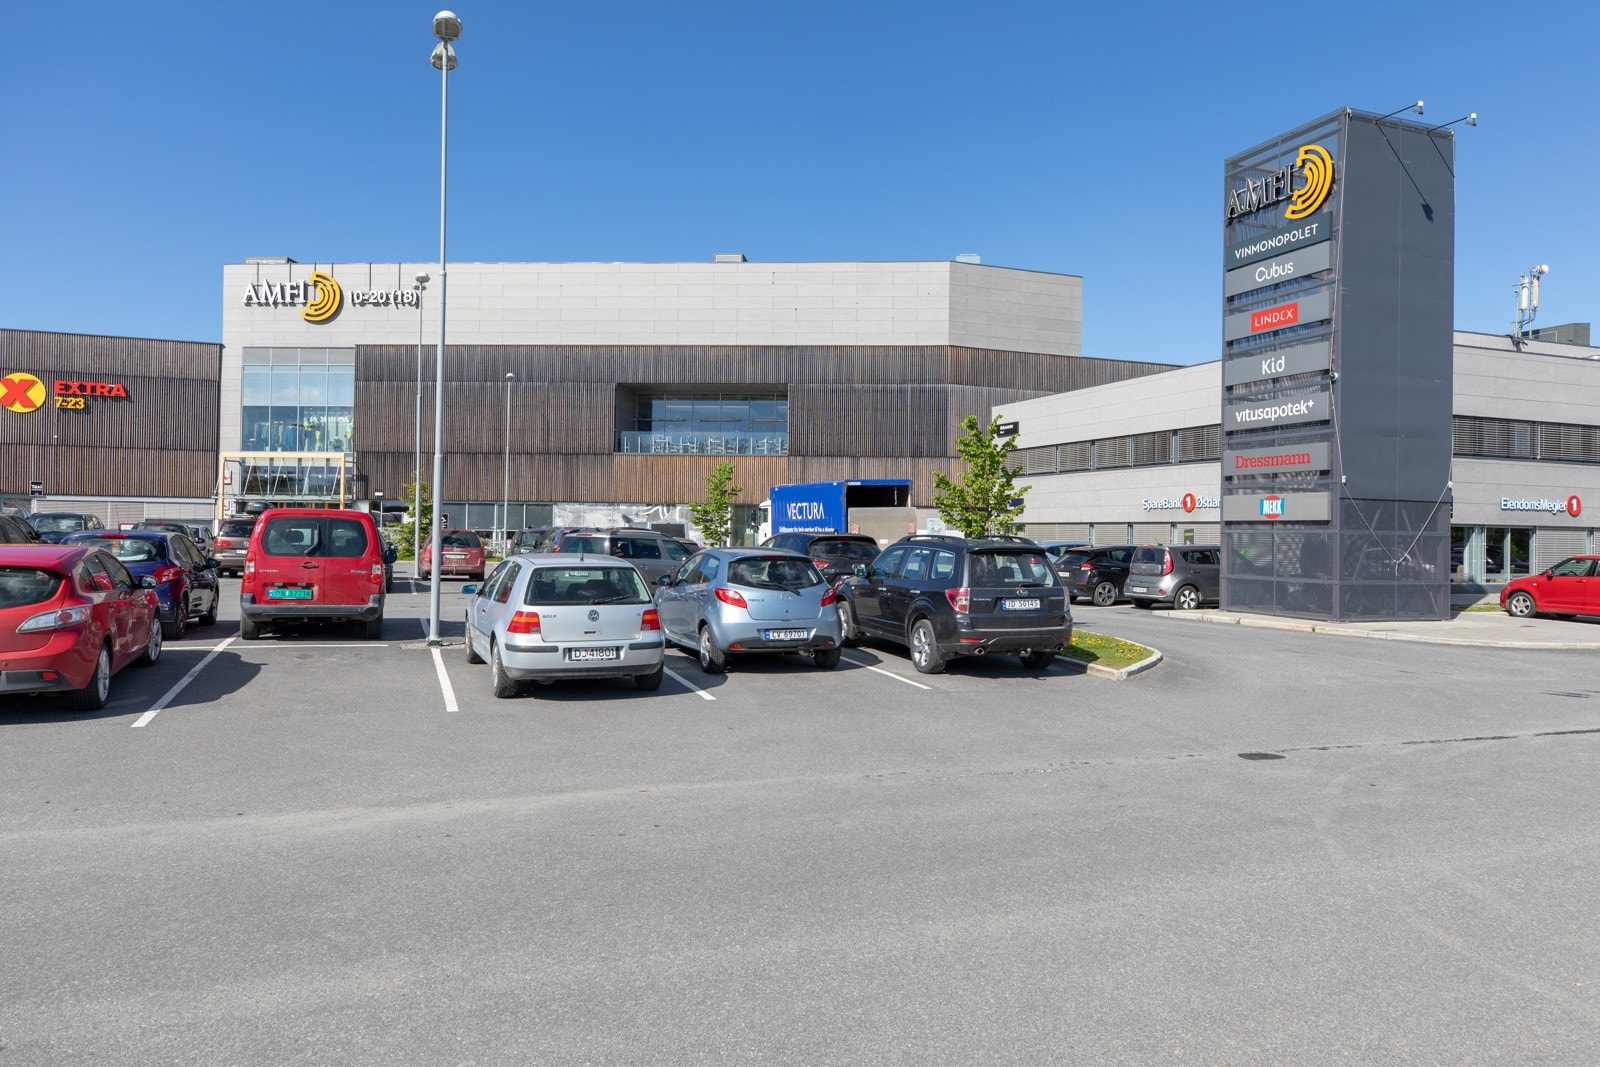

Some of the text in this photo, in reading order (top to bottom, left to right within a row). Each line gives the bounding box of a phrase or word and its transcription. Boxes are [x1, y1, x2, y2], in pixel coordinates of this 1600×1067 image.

[1225, 163, 1294, 220] AMFI
[1234, 223, 1319, 260] VINMONOPOLET
[1255, 261, 1294, 283] Cubus
[243, 279, 306, 304] AMFI
[346, 289, 417, 305] 10-20 (18)
[1254, 308, 1294, 328] LINDEX
[1261, 356, 1286, 375] Kid
[54, 380, 127, 398] EXTRA
[54, 398, 86, 410] 7-23
[1234, 451, 1312, 470] Dressmann
[786, 502, 826, 520] VECTURA
[1142, 496, 1183, 512] SpareBank
[1263, 499, 1283, 515] MEKK
[1500, 497, 1567, 514] EiendomsMegler
[1007, 599, 1038, 608] JD 50145
[772, 630, 805, 639] CV 69701
[588, 648, 615, 658] 41801
